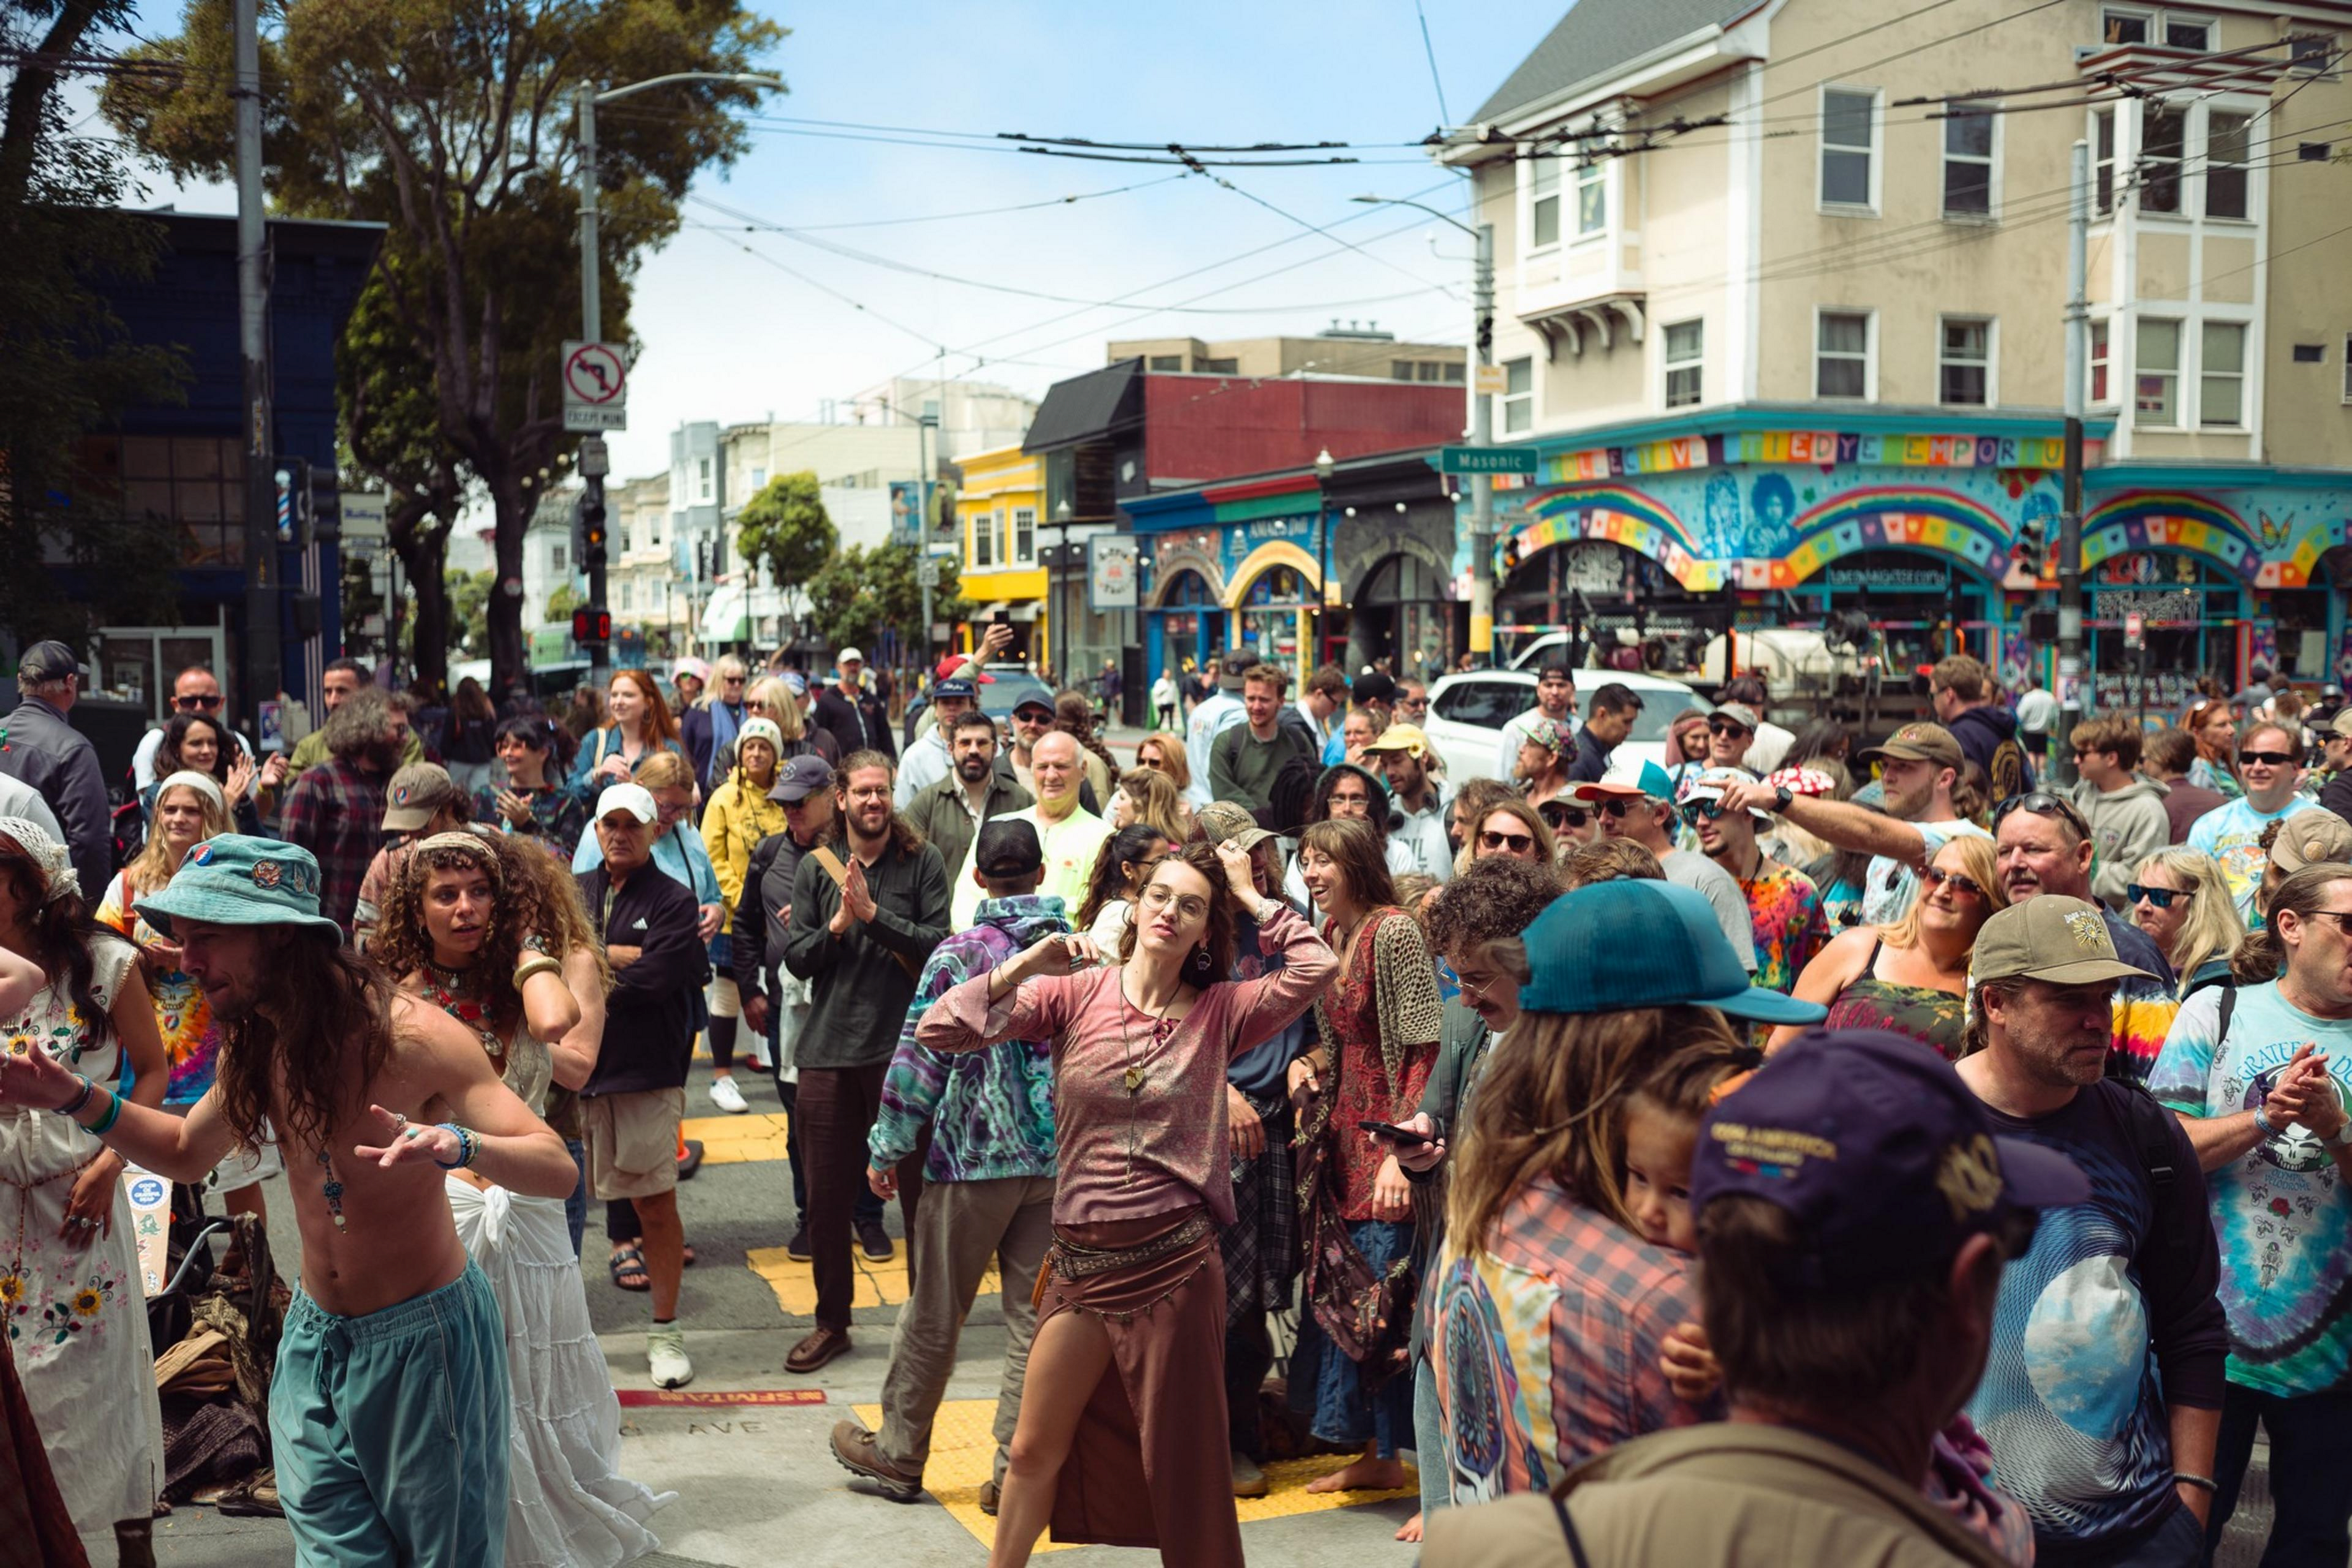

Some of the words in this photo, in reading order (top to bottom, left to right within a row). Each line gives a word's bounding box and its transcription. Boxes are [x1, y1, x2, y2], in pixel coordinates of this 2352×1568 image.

[1907, 433, 2060, 462] EMPORIU
[1458, 453, 1522, 470] Masonic
[2236, 1040, 2326, 1080] GRATEF
[2264, 1174, 2312, 1191] VELODROME
[2271, 1169, 2305, 1183] OLYMPIC
[682, 1391, 795, 1403] SFMTA
[689, 1419, 768, 1436] AVE
